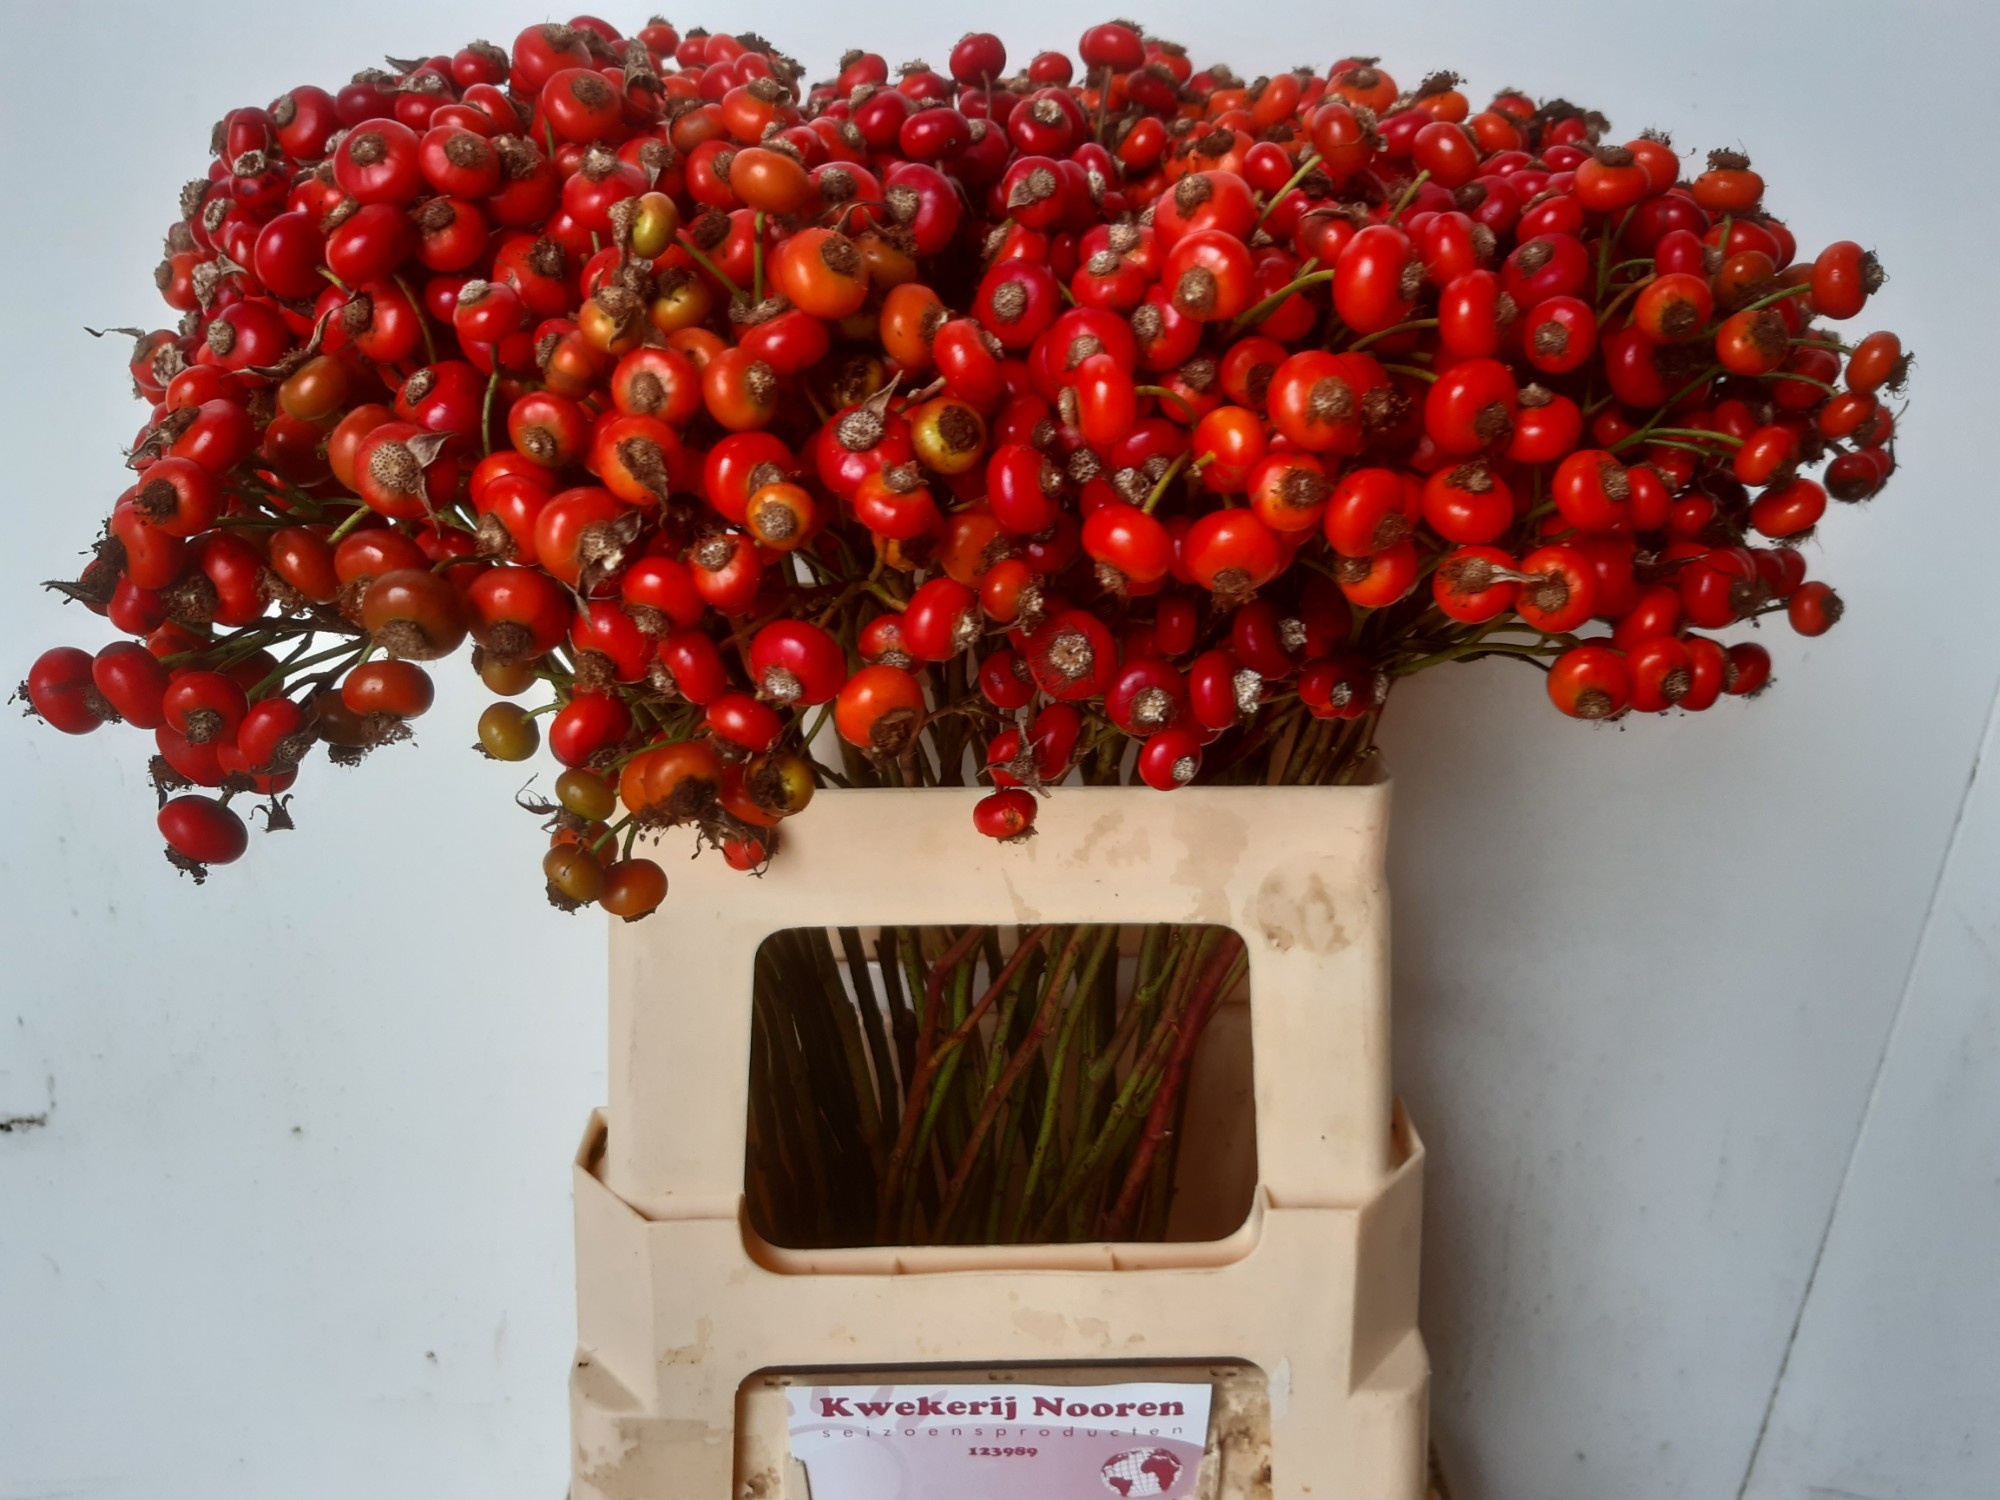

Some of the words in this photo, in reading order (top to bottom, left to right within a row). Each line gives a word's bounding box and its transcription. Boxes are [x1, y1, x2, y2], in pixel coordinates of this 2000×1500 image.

[820, 1396, 1017, 1420] Kwekerij
[1033, 1396, 1184, 1417] Nooren
[822, 1425, 1183, 1441] seizoensproducten
[968, 1446, 1038, 1458] 123989
